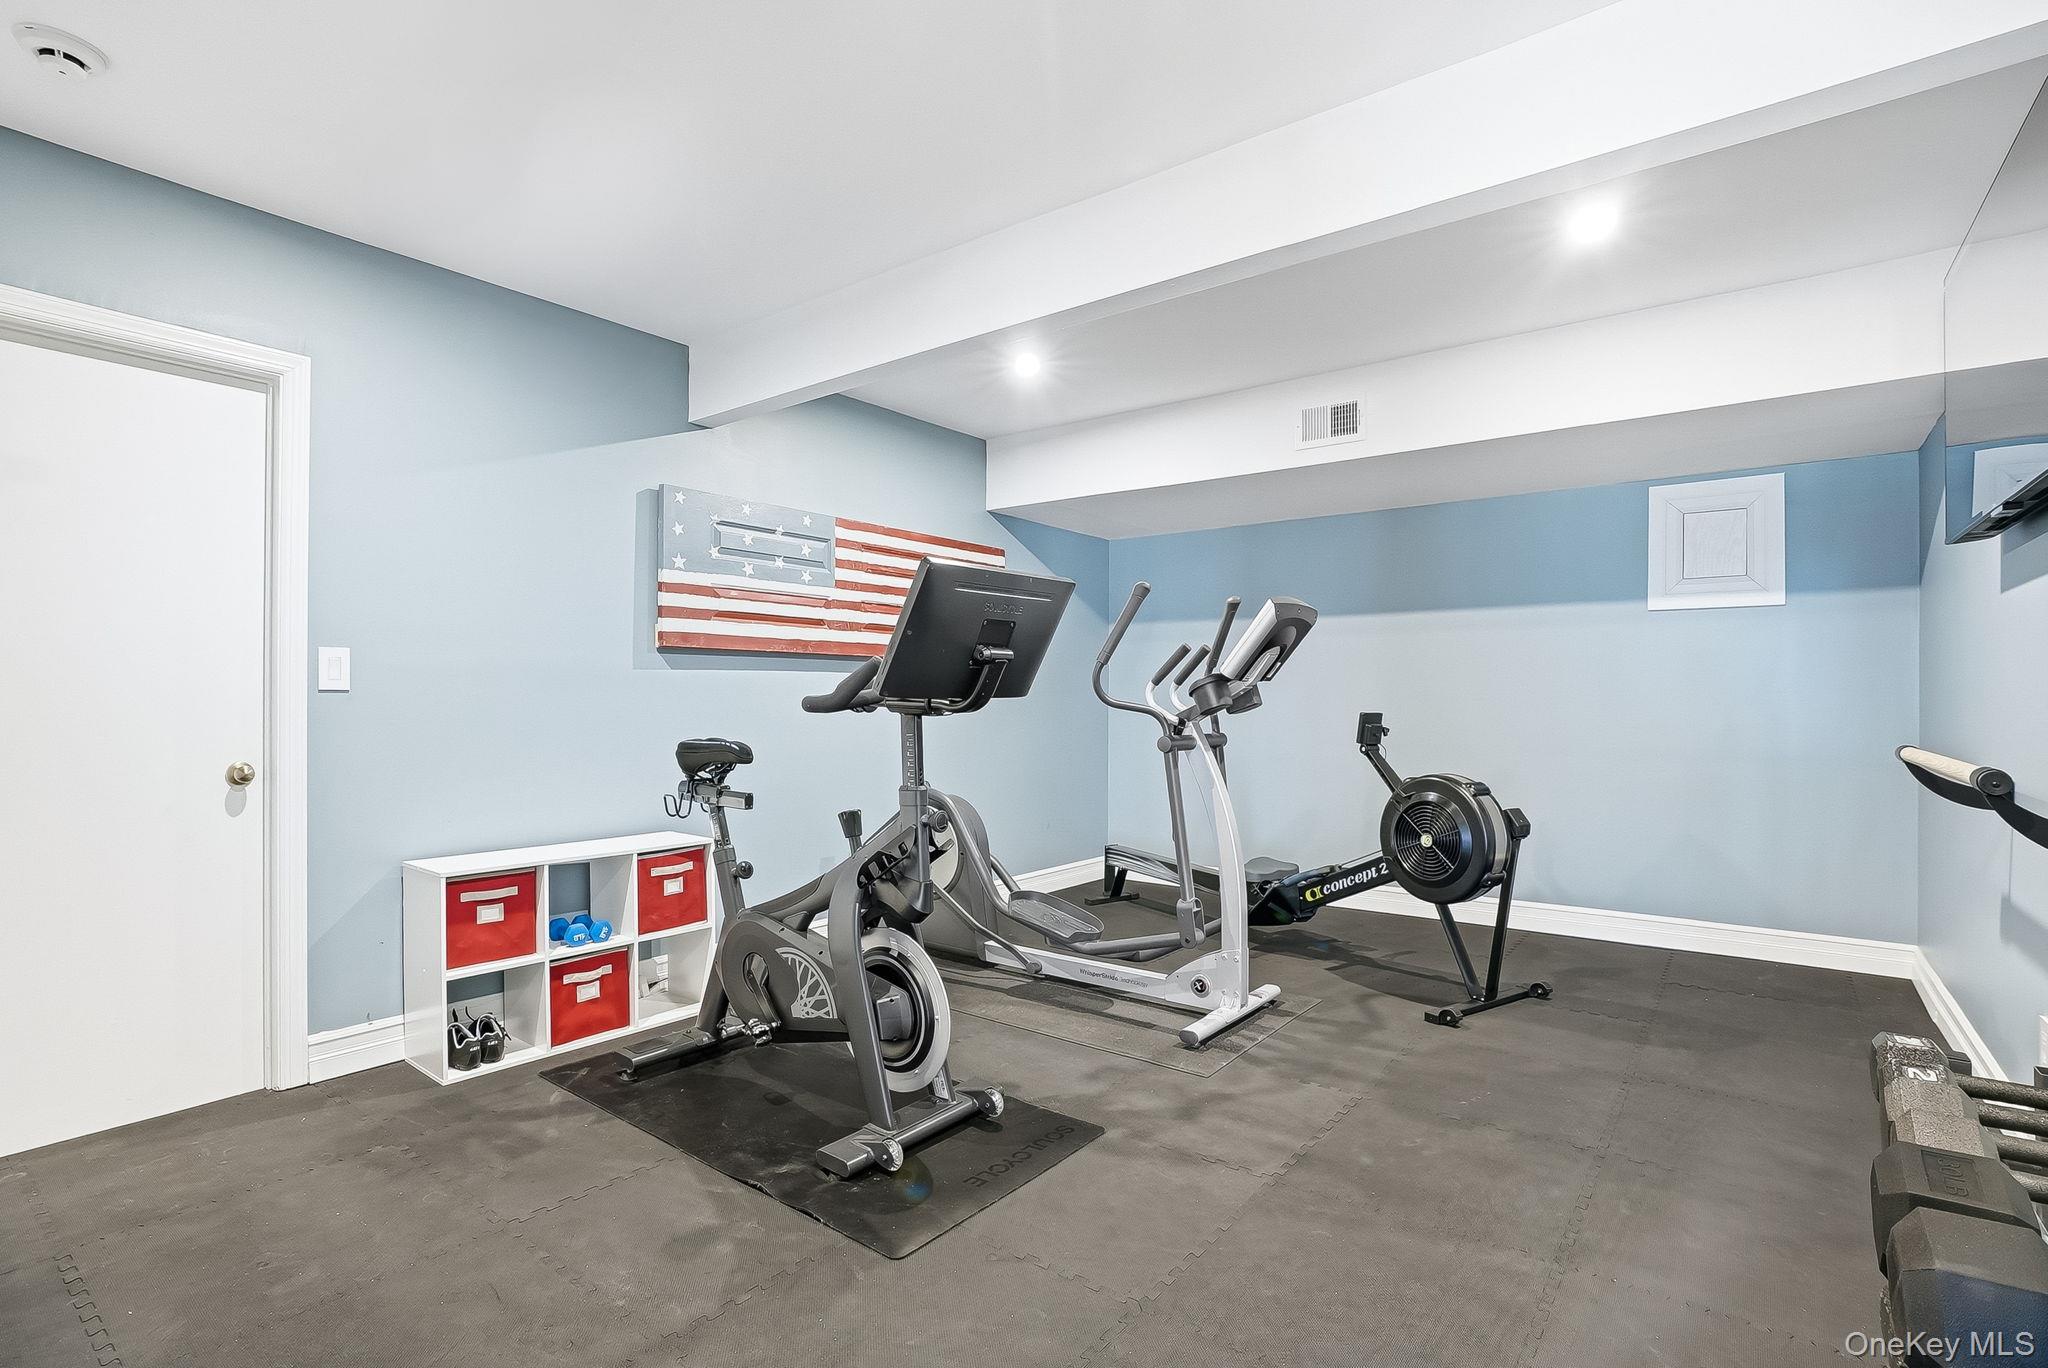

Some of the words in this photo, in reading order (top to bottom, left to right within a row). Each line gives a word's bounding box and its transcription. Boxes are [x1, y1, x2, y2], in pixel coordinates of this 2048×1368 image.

[1323, 866, 1378, 895] concept
[1379, 862, 1389, 875] 2
[963, 1125, 1075, 1187] SOULCYCLE
